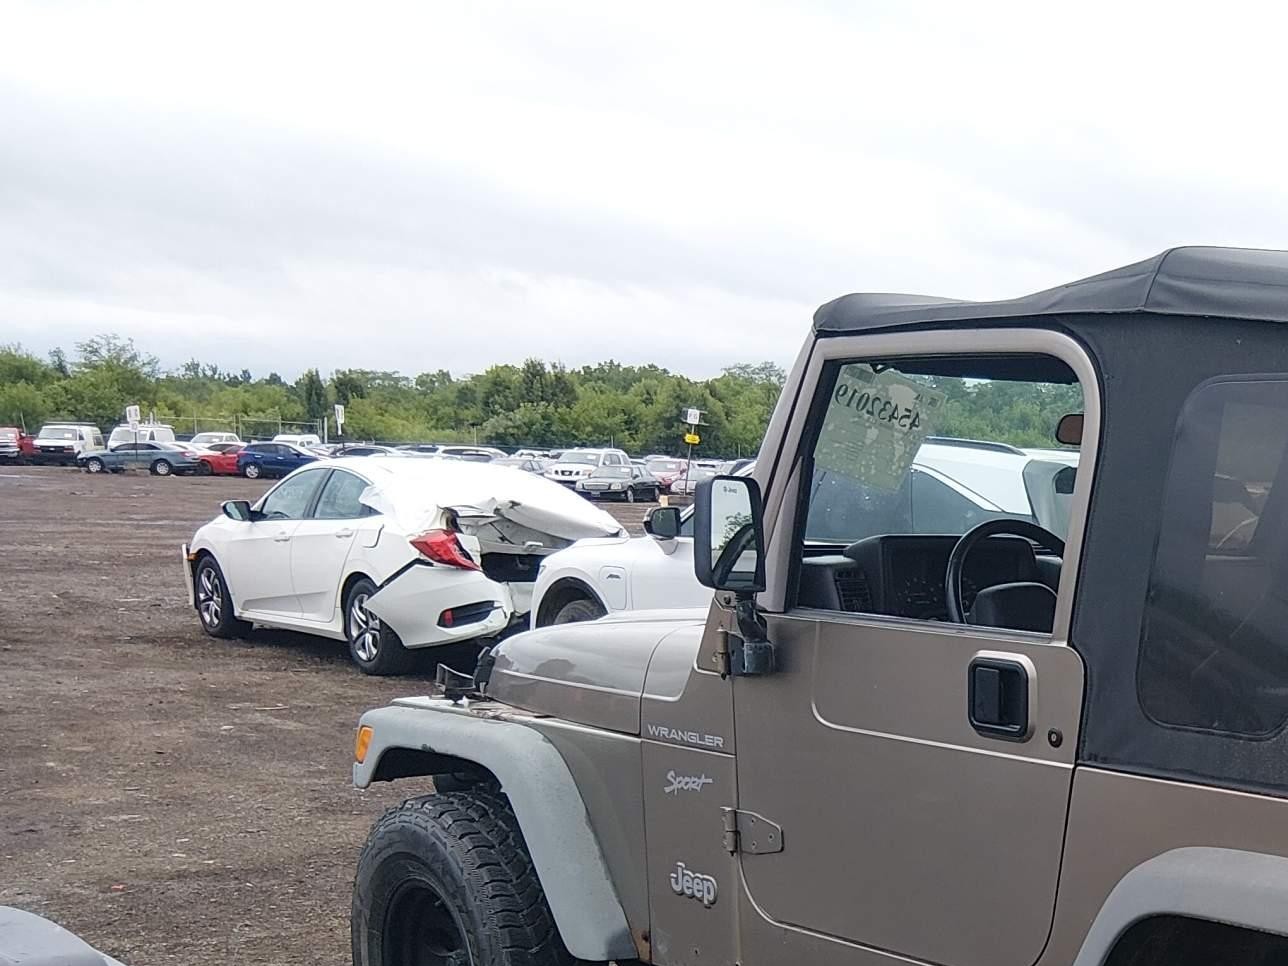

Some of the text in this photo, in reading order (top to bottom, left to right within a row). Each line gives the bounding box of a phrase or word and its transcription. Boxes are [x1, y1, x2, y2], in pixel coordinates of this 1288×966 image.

[647, 723, 724, 748] WRANGLER
[664, 769, 713, 795] Sport
[670, 862, 718, 907] Jeep
